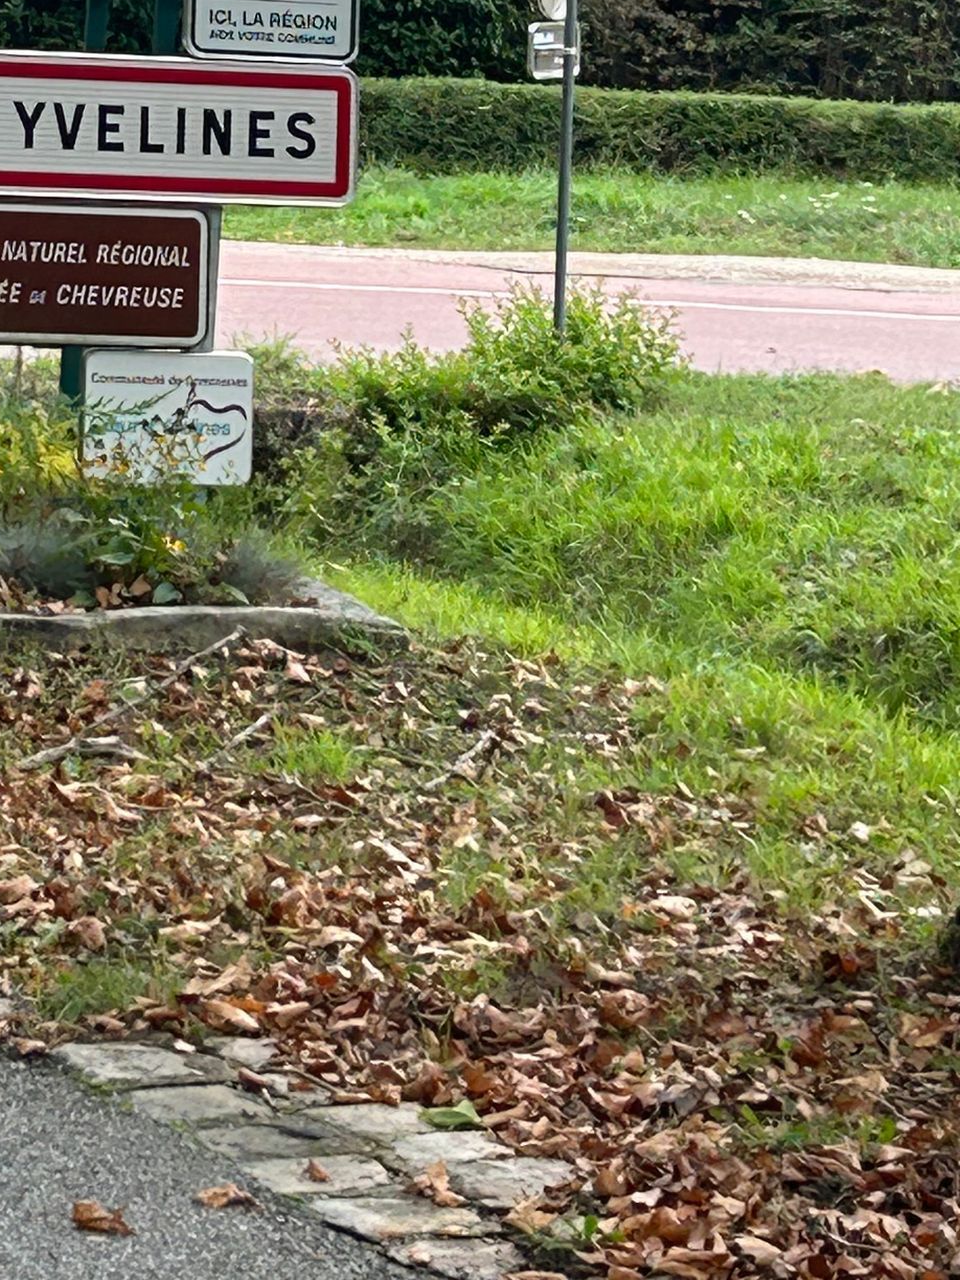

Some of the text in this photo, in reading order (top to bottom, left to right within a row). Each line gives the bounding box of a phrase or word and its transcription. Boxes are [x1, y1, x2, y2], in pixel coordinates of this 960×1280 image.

[242, 10, 265, 27] LA
[269, 7, 338, 31] RÉGION
[13, 100, 317, 160] YVELINES
[0, 240, 87, 263] NATUREL
[95, 241, 191, 267] RÉGIONAL
[56, 283, 185, 309] CHEVREUSE
